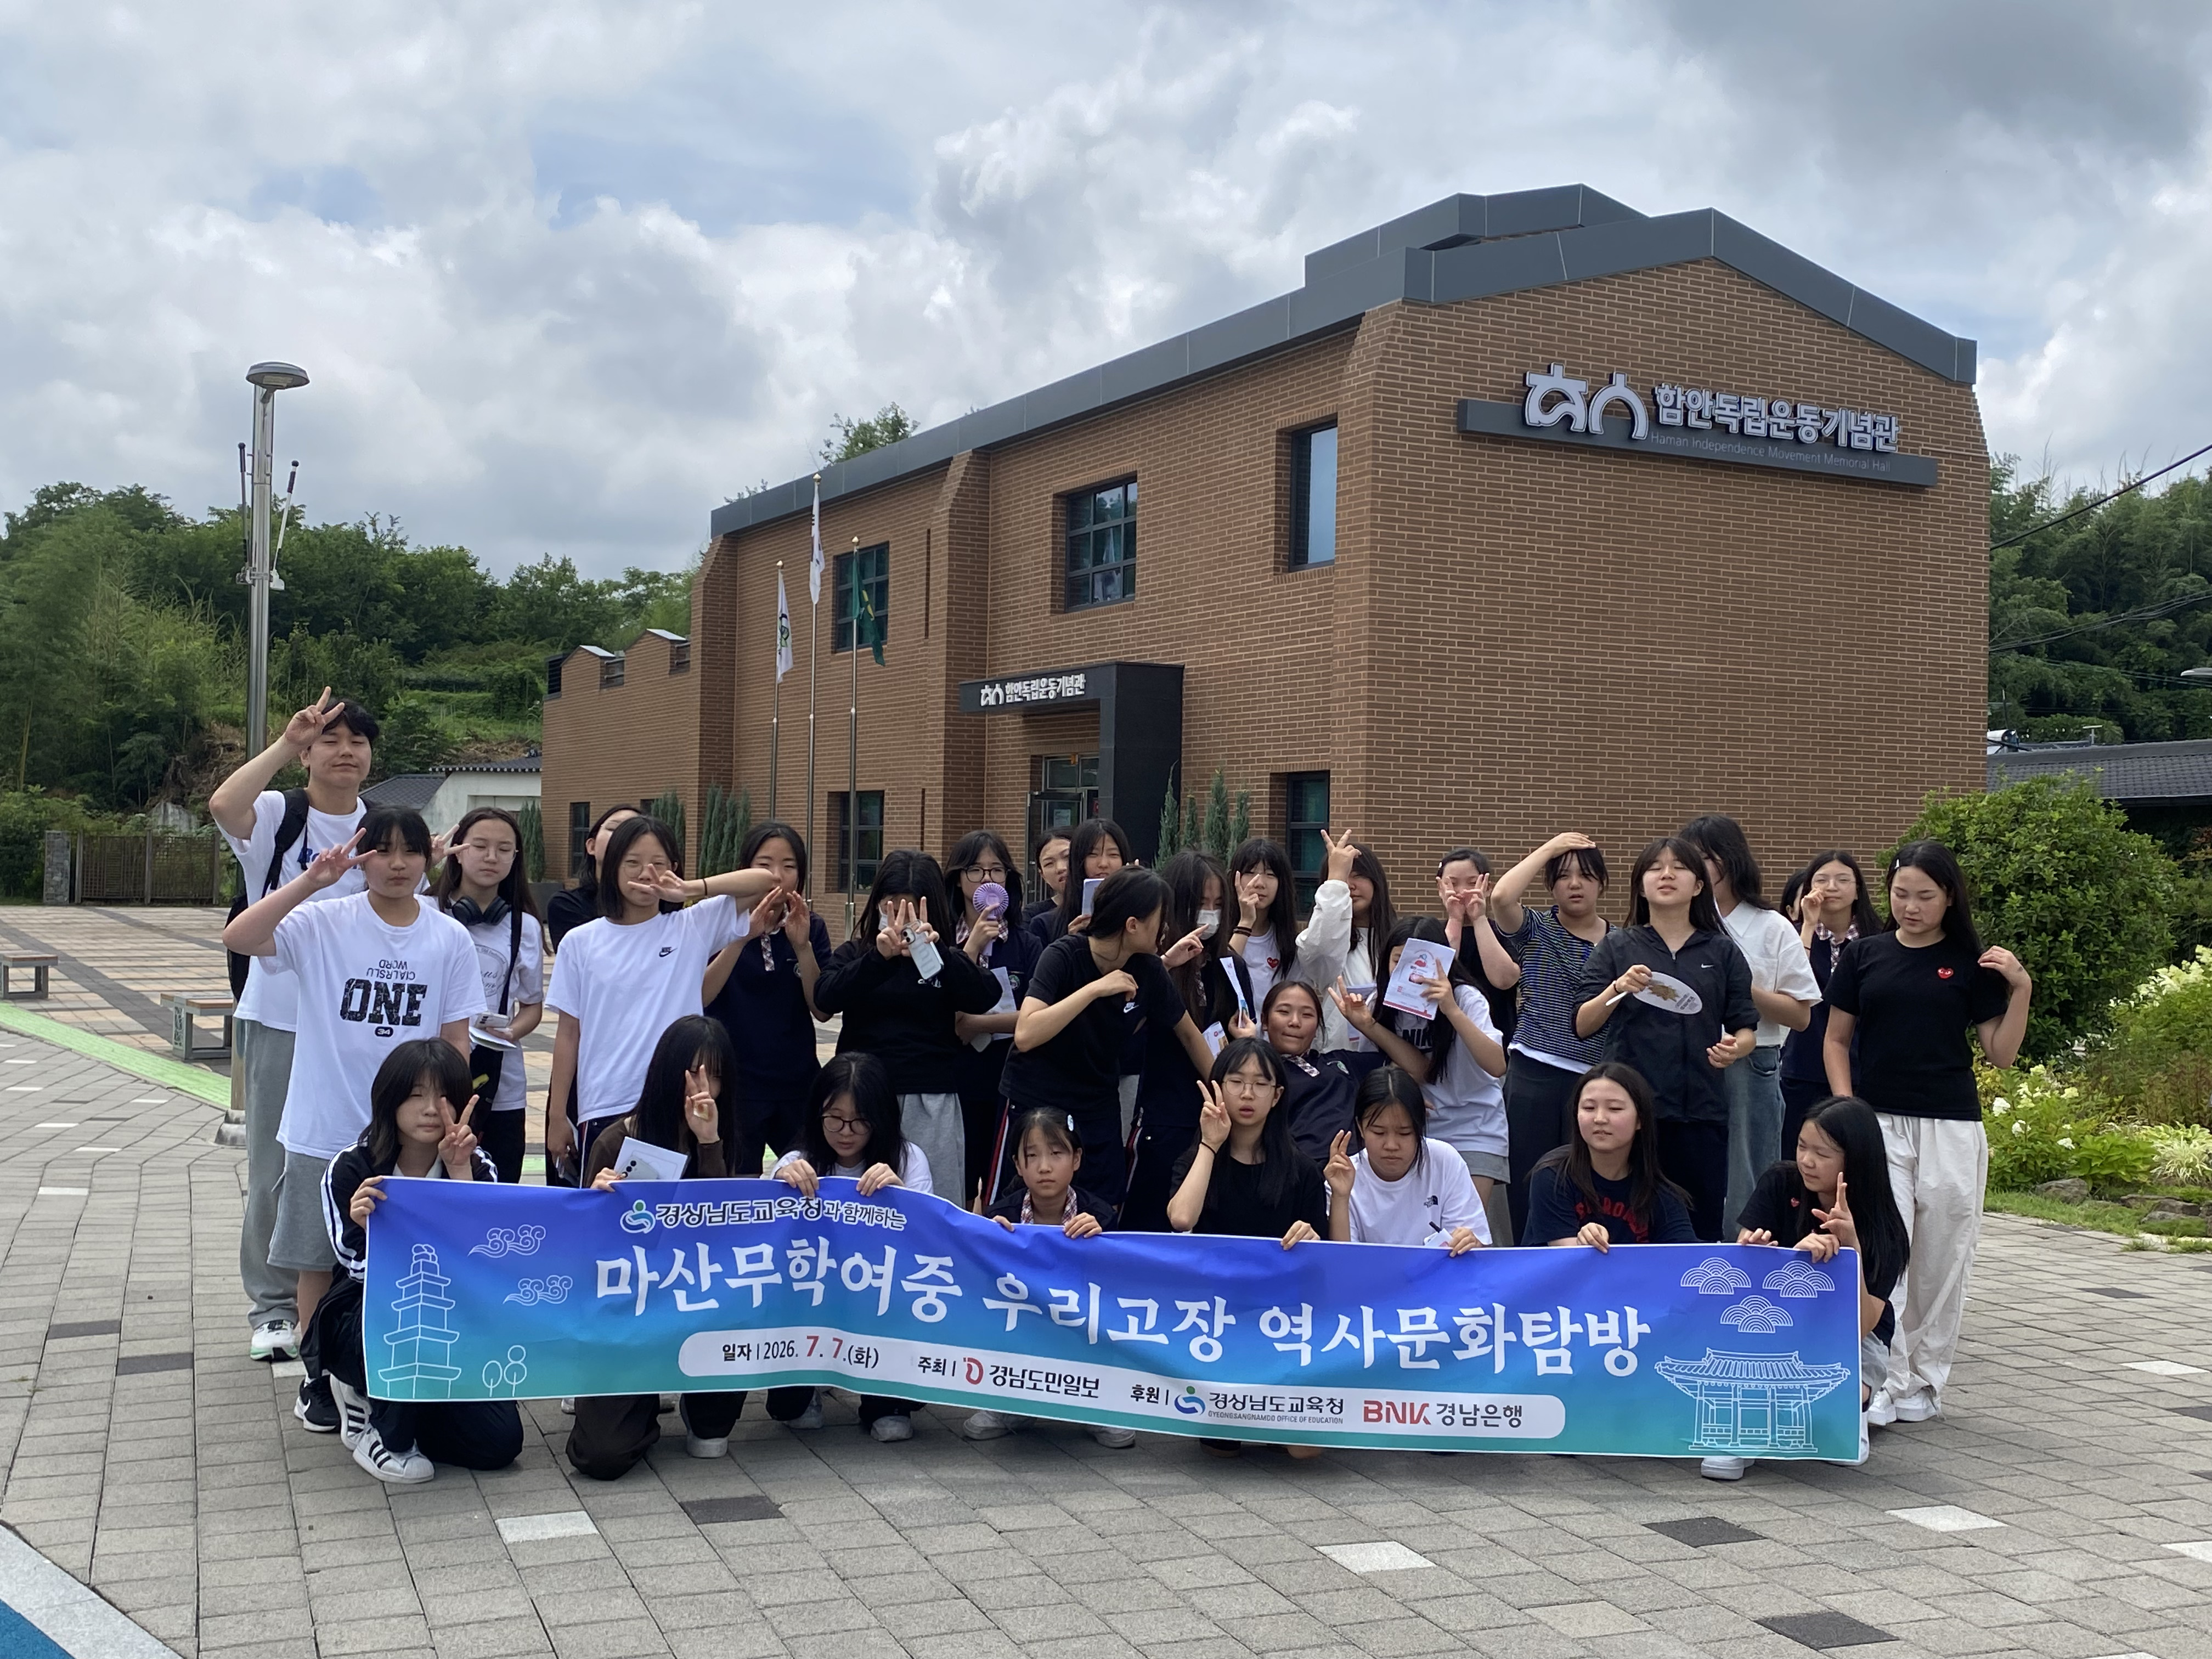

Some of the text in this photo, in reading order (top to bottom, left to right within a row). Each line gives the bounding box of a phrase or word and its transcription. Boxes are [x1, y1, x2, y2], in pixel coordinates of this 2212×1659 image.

[1655, 383, 1900, 452] 함안독립운동기념관
[1650, 433, 1891, 472] Haman Independence Movement Memorial Hall
[1005, 674, 1086, 703] 함안독립운동기념관
[340, 978, 427, 1026] ONE
[1402, 1028, 1431, 1046] NIK
[843, 1201, 907, 1231] 함께하는
[596, 1235, 1651, 1377] 마산무학여중 우리고장 역사문화탐방
[722, 1344, 752, 1362] 일자
[763, 1340, 798, 1359] 2026.
[918, 1356, 946, 1376] 주최
[989, 1364, 1100, 1399] 경남도민일보
[1131, 1384, 1160, 1404] 후원
[1209, 1392, 1344, 1415] 경상남도교육청
[1363, 1400, 1431, 1425] BNK
[1436, 1403, 1522, 1427] 경남은행
[1208, 1410, 1276, 1421] GYEONGSANGNAMDO
